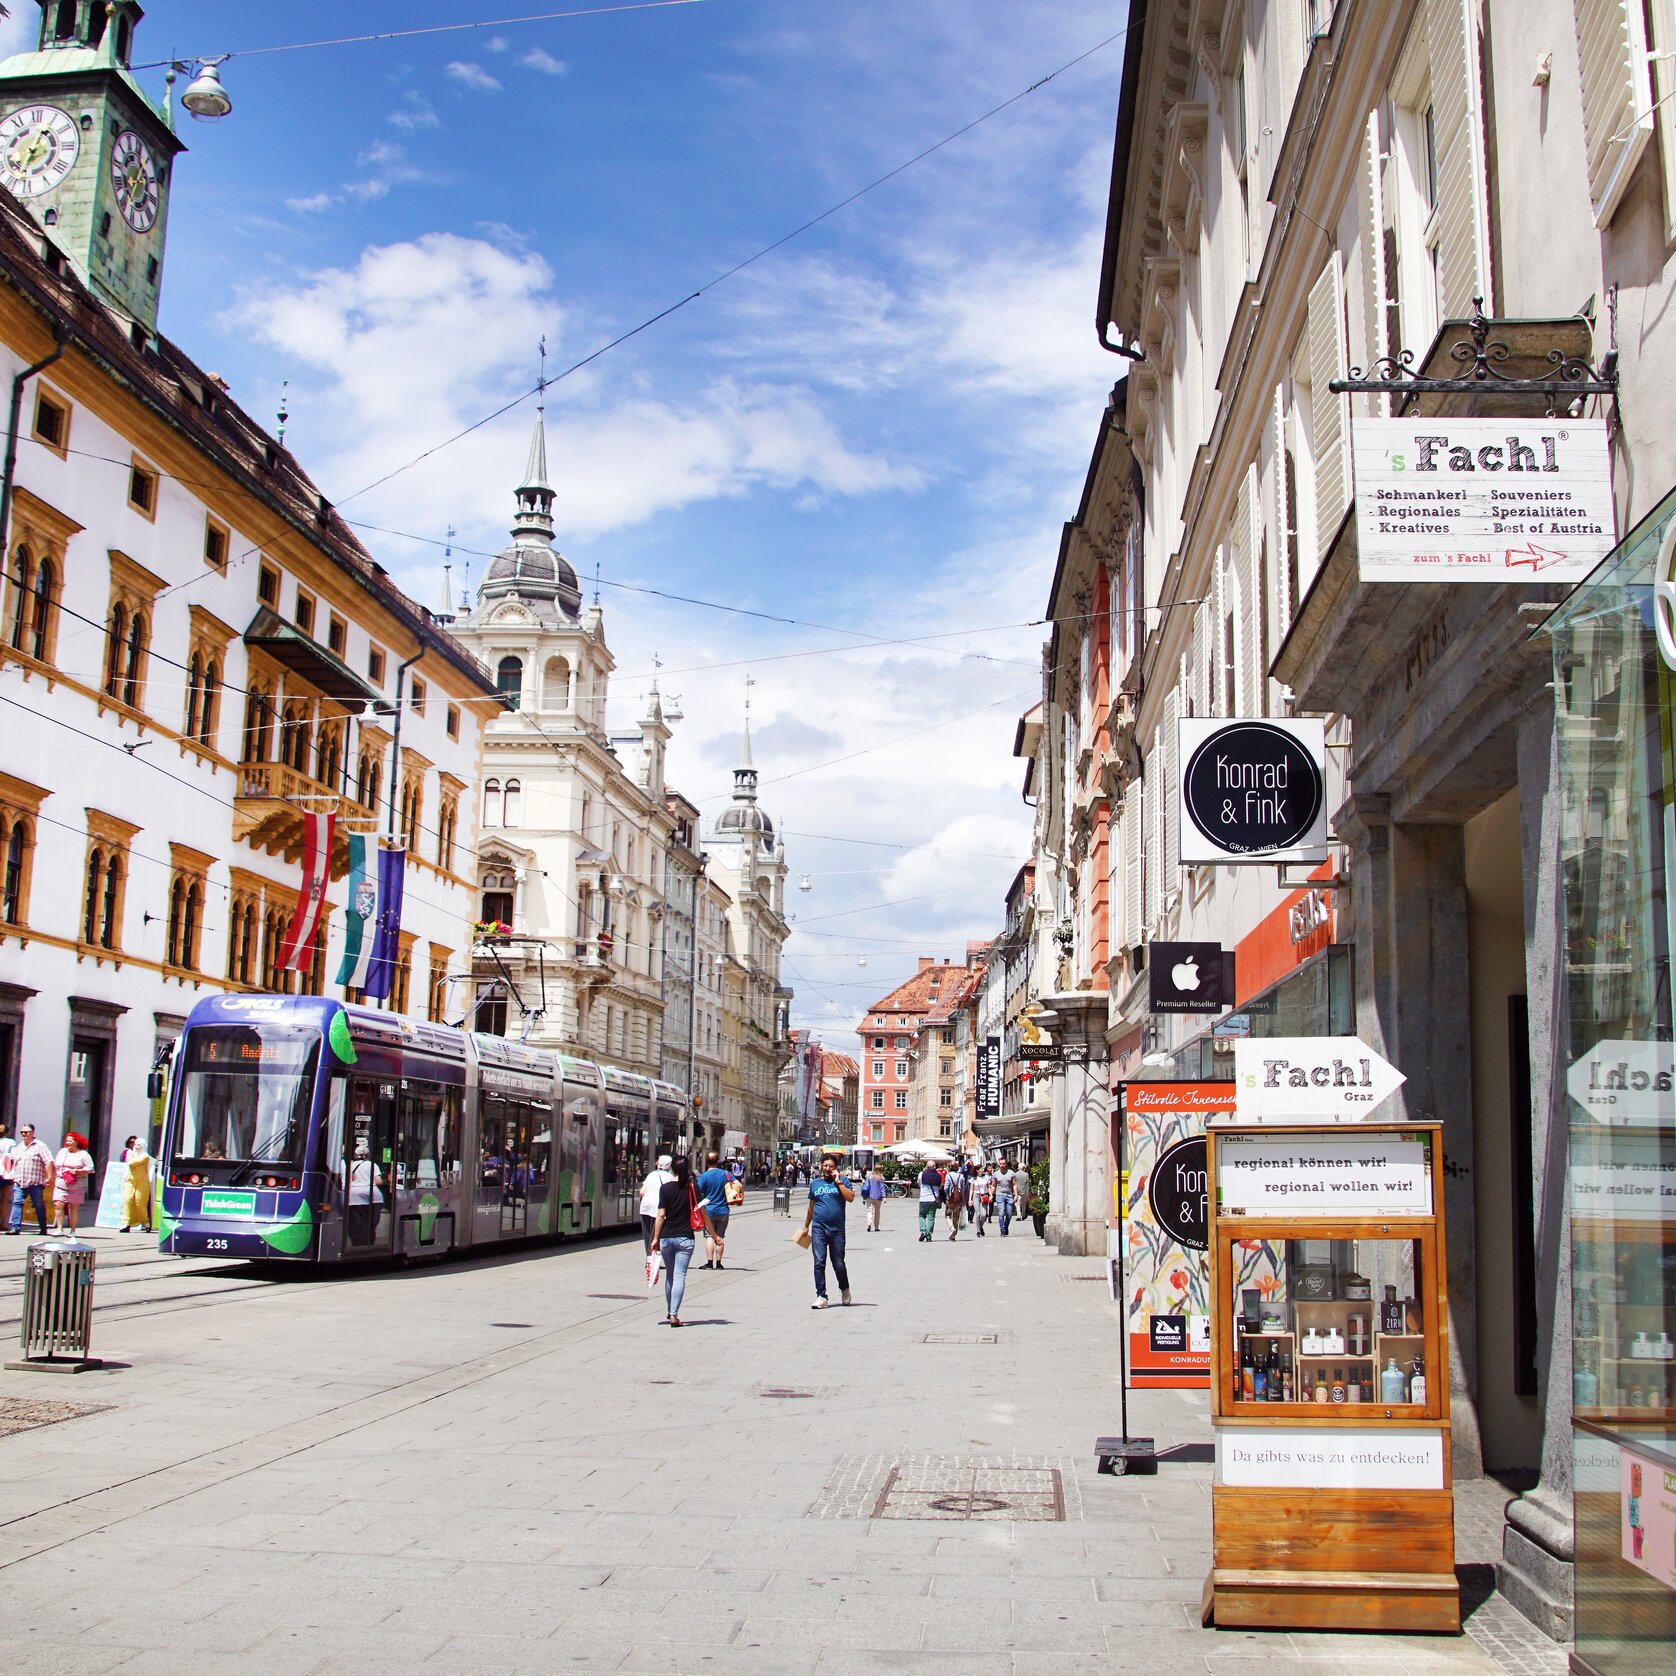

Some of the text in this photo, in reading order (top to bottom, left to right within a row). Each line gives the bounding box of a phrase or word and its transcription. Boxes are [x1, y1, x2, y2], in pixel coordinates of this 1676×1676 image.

[1414, 436, 1560, 472] Fachl
[1377, 489, 1466, 500] Schmankerl
[1490, 489, 1572, 501] Souveniers
[1378, 506, 1461, 518] Regionales
[1492, 506, 1587, 519] Spezialitäten
[1380, 523, 1450, 534] Kreatives
[1494, 522, 1602, 534] Best of Austria
[1414, 554, 1440, 563] zum
[1457, 554, 1491, 563] Fachl
[1217, 754, 1288, 788] Konrad
[1221, 800, 1237, 824] &
[1229, 842, 1278, 852] GRAZ WIEN
[1189, 1000, 1216, 1008] Reseller
[1022, 1047, 1059, 1056] XOCOLAT
[988, 1045, 999, 1106] HUMANIC
[1263, 1059, 1373, 1088] Fachl
[978, 1089, 987, 1112] Frag
[1134, 1090, 1180, 1106] Stilvolle
[1344, 1092, 1374, 1102] Graz
[1234, 1157, 1386, 1171] regional können wir!
[1265, 1180, 1413, 1195] regional wollen wir!
[1180, 1201, 1194, 1223] &
[207, 1239, 228, 1249] 235
[1186, 1238, 1204, 1247] GRAZ
[1232, 1450, 1430, 1464] Da gibts was zu entdecken!
